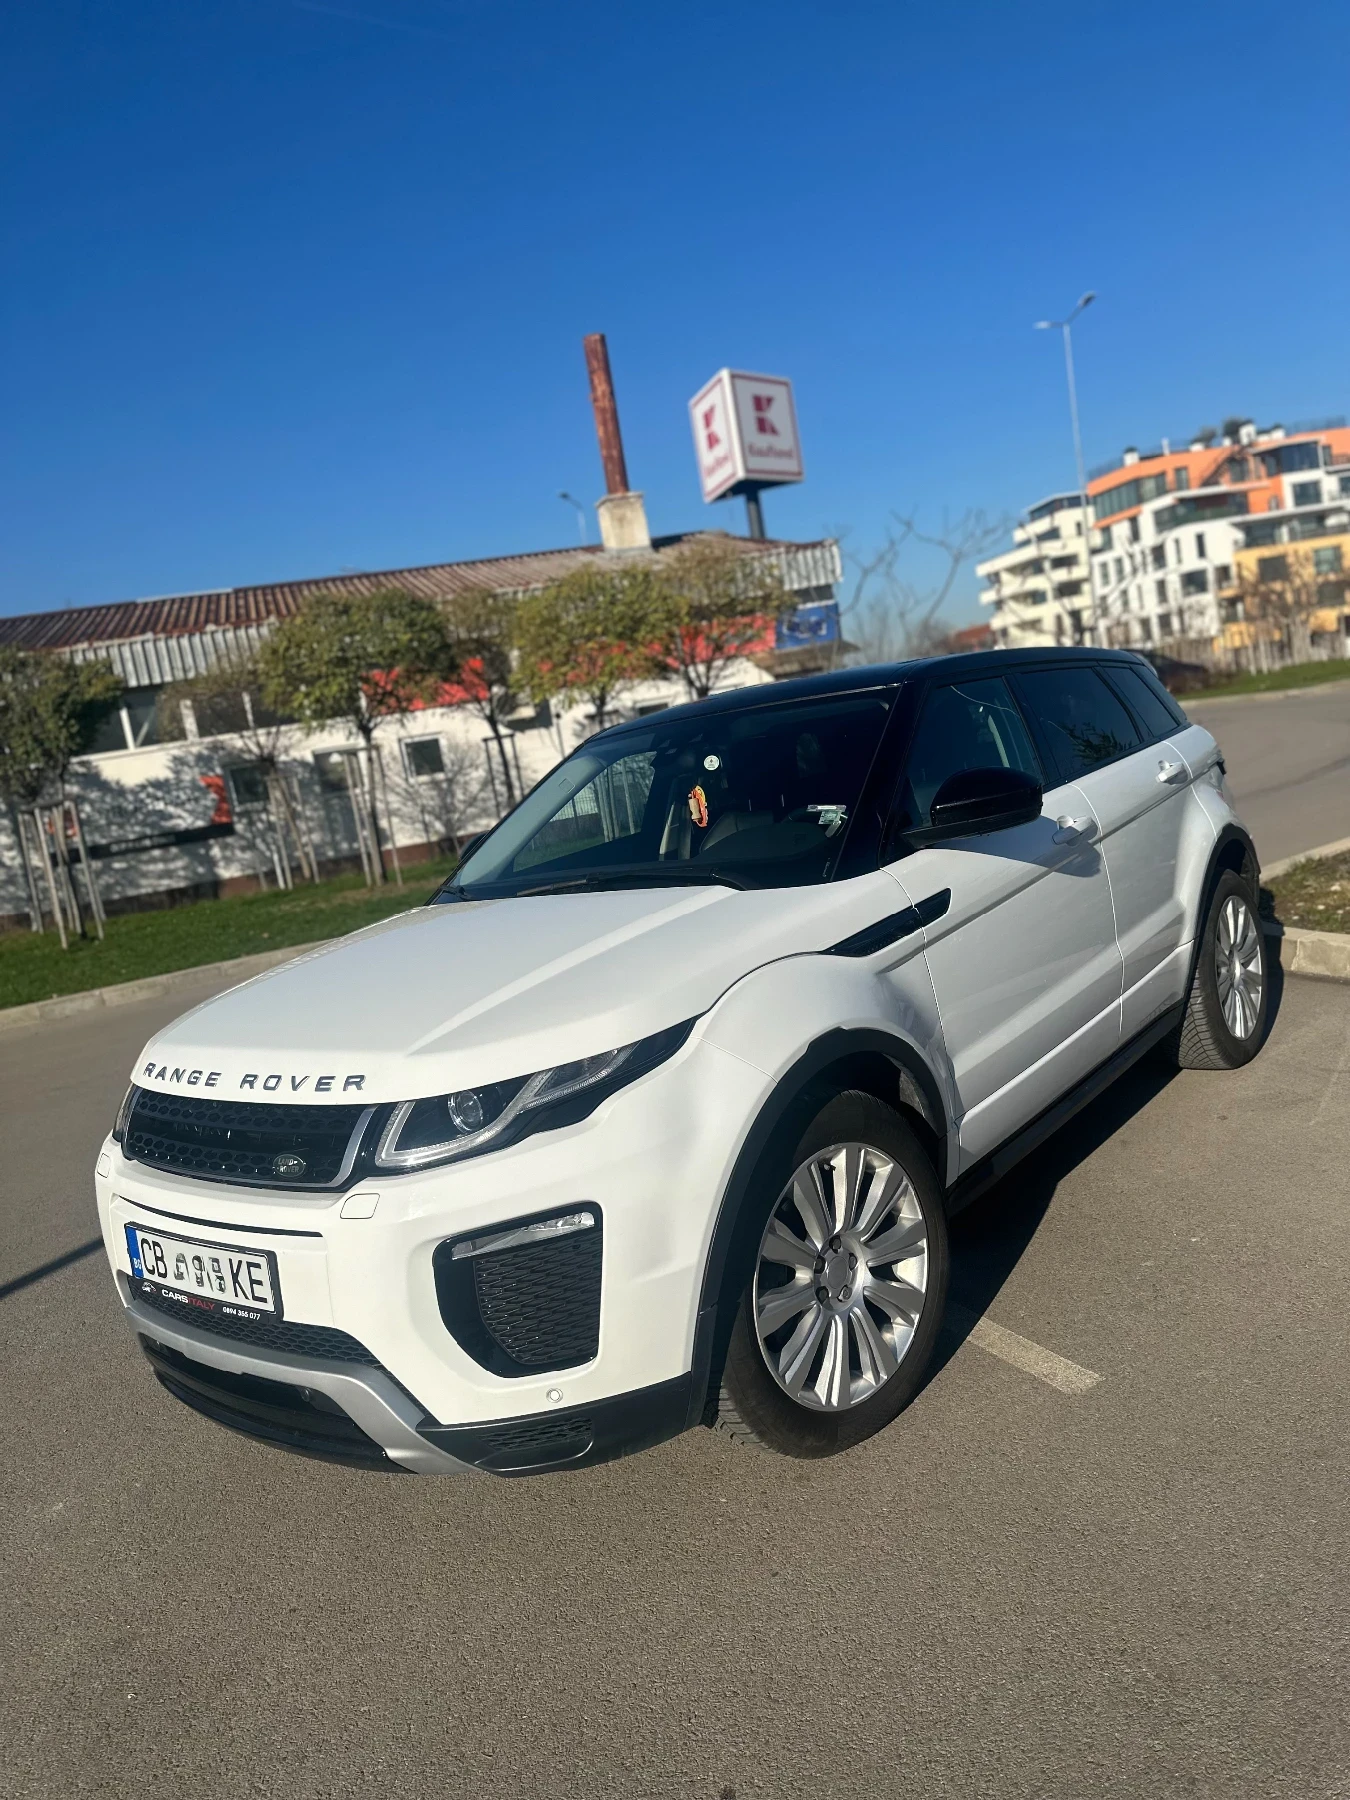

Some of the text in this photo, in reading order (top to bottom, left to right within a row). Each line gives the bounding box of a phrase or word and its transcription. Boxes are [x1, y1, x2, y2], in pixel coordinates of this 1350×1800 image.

[703, 404, 722, 450] K
[752, 394, 778, 436] K
[143, 1062, 366, 1092] RANGE ROVER
[141, 1238, 168, 1278] CB
[229, 1258, 268, 1303] KE
[249, 1312, 261, 1321] 077
